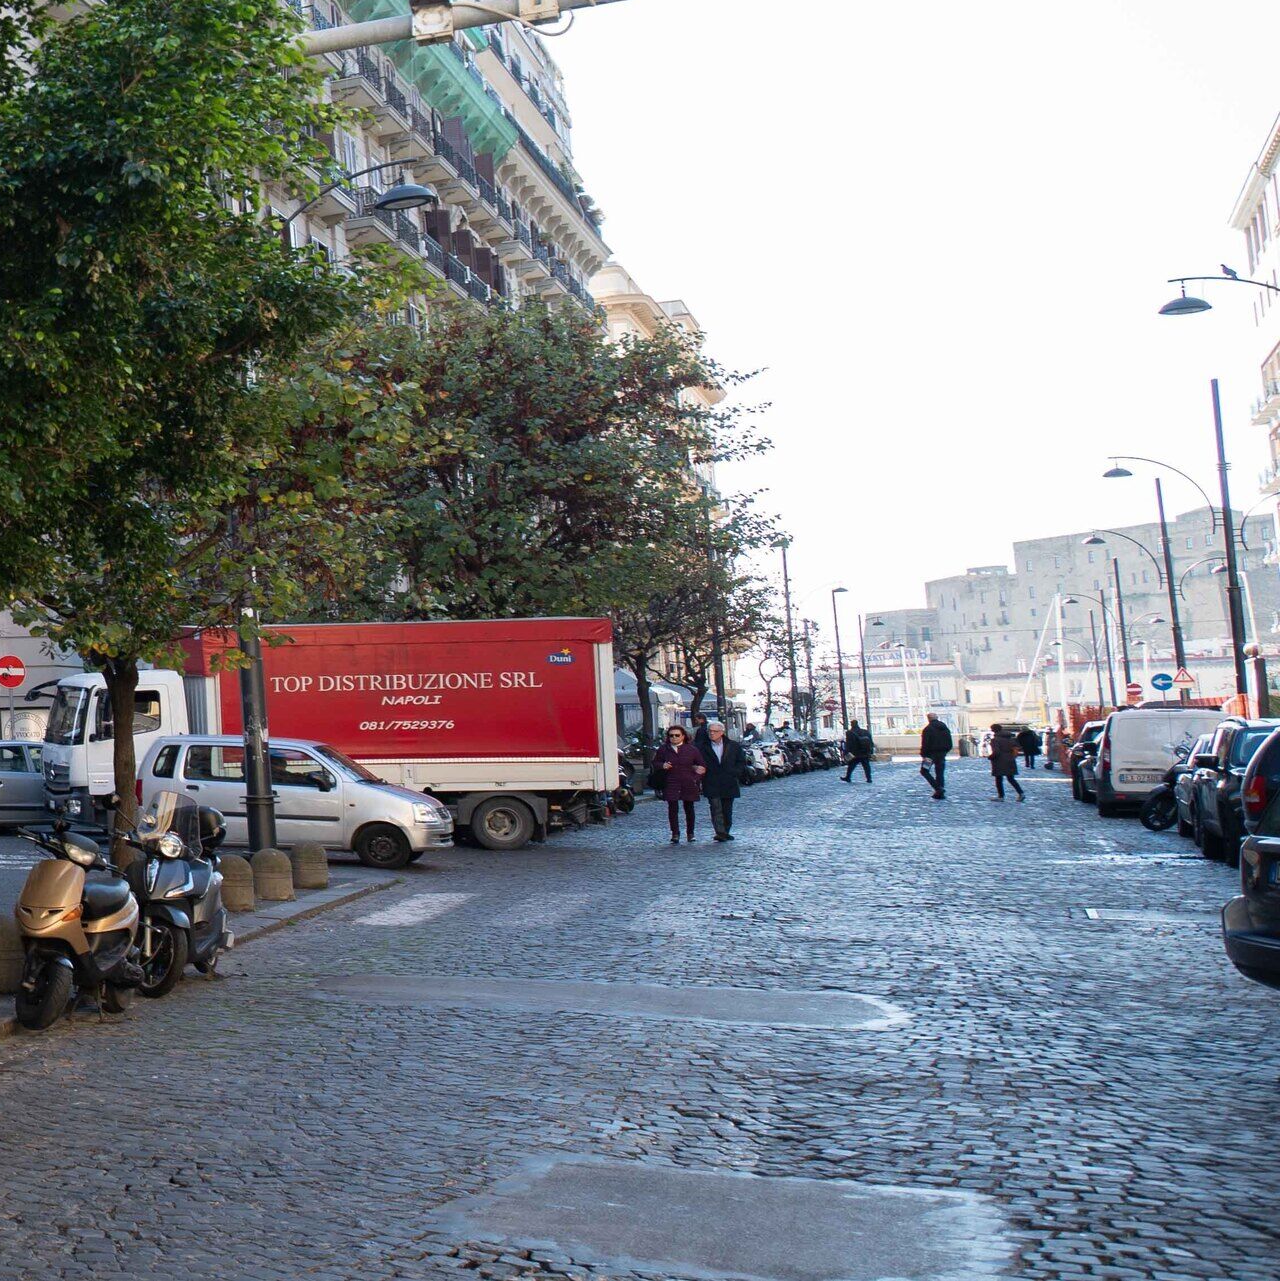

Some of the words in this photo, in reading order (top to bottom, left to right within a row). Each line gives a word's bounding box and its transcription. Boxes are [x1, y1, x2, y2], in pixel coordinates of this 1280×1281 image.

[549, 653, 572, 663] Duni
[270, 676, 313, 693] TOP
[317, 673, 493, 692] DISTRIBUZIONE
[499, 671, 544, 689] SRL
[381, 694, 443, 706] NAPOLI
[359, 719, 455, 732] 081/7529376
